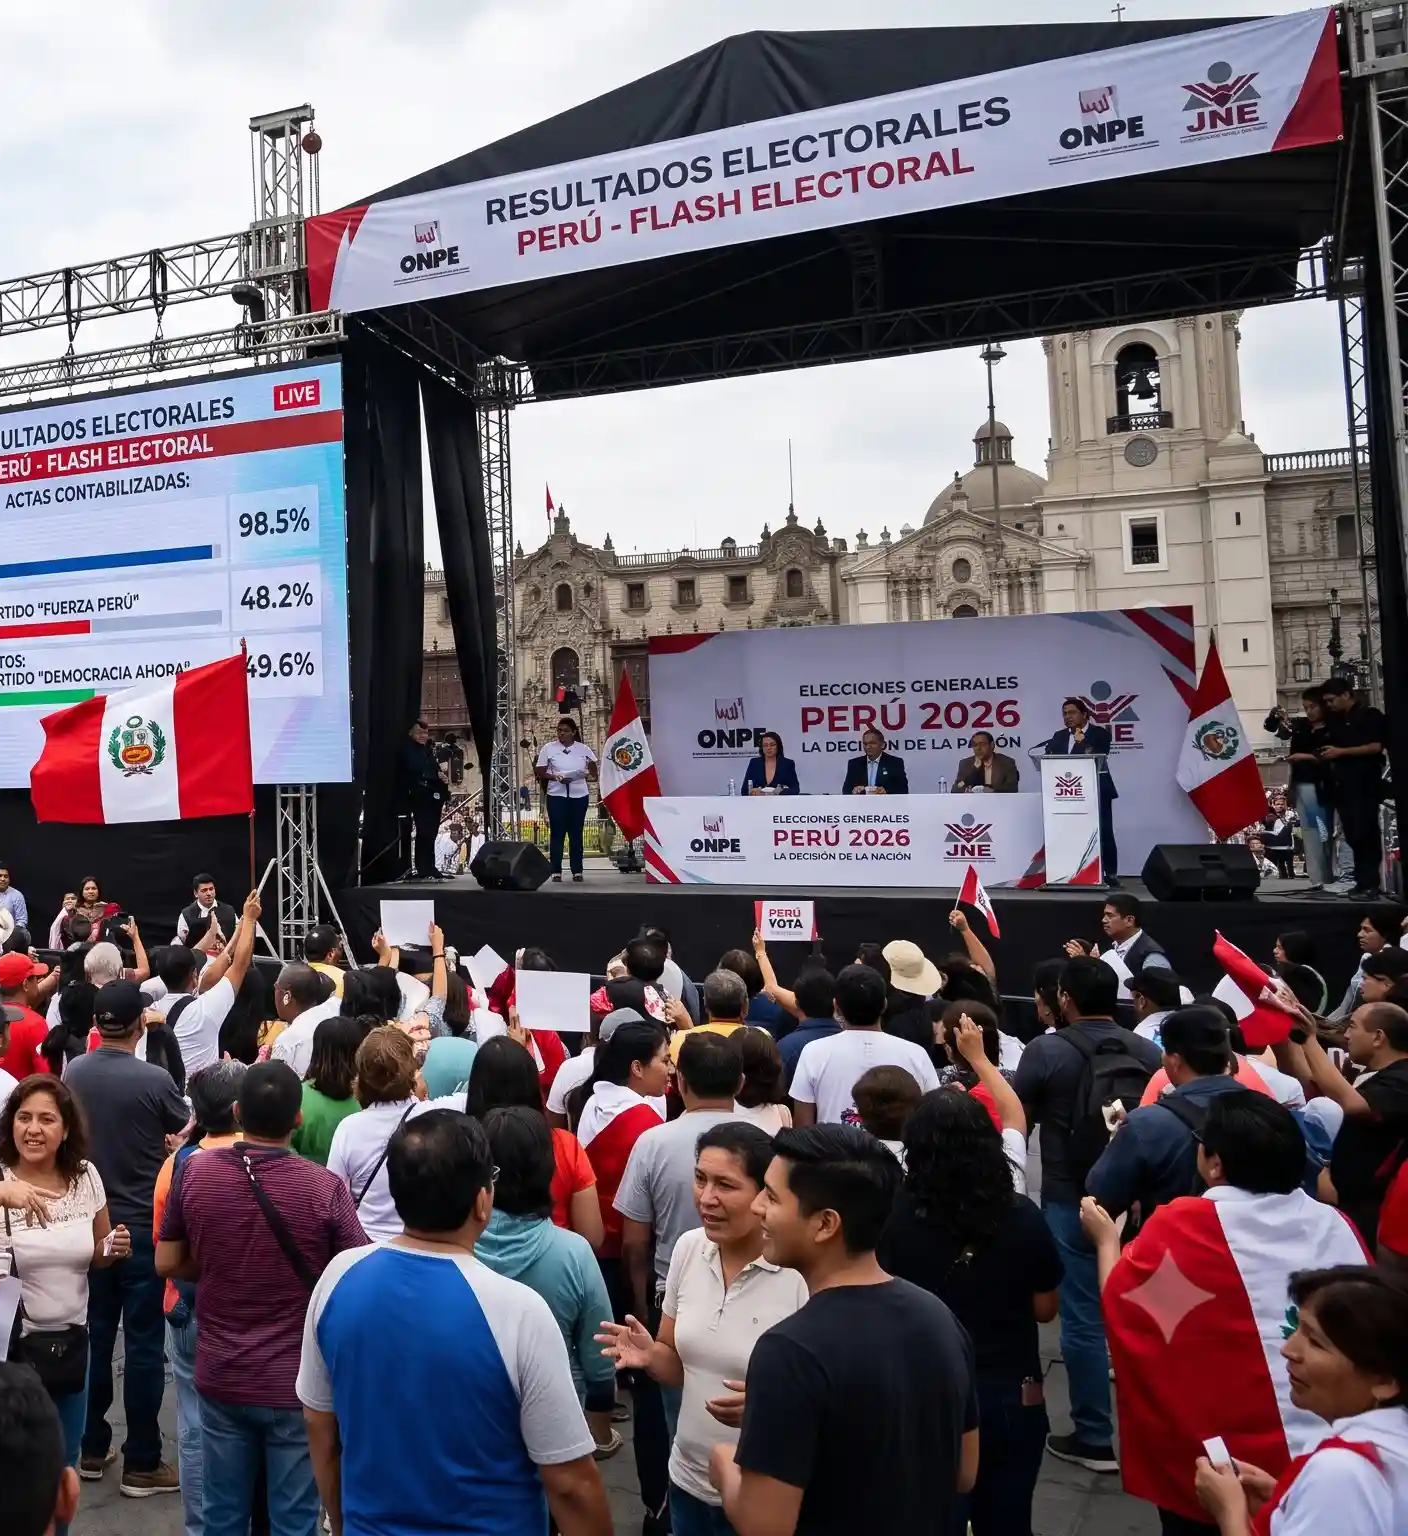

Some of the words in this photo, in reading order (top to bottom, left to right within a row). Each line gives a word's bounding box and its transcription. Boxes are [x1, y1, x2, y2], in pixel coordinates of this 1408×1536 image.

[1186, 102, 1260, 132] JNE
[1060, 115, 1144, 149] ONPE
[486, 156, 711, 225] RESULTADOS
[723, 96, 1011, 177] ELECTORALES
[518, 210, 602, 256] PERÚ
[630, 188, 741, 235] FLASH
[752, 147, 975, 210] ELECTORAL
[400, 246, 460, 273] ONPE
[279, 385, 316, 405] LIVE
[92, 396, 235, 437] ELECTORALES
[47, 447, 103, 474] FLASH
[108, 433, 214, 467] ELECTORAL
[5, 491, 52, 509] ACTAS
[55, 472, 190, 504] CONTABILIZADAS:
[239, 506, 310, 538] 98.5%
[241, 583, 314, 610] 48.2%
[799, 681, 906, 697] ELECCIONES
[911, 676, 1019, 693] GENERALES
[801, 697, 906, 733] PERÚ
[919, 699, 1021, 730] 2026
[802, 742, 821, 752] LA
[905, 738, 927, 751] DE
[932, 737, 952, 750] LA
[1056, 788, 1083, 796] JNE
[772, 815, 840, 824] ELECCIONES
[843, 814, 909, 823] GENERALES
[690, 838, 741, 853] ONPE
[773, 824, 840, 847] PERÚ
[849, 828, 910, 847] 2026
[773, 852, 787, 861] LA
[789, 850, 836, 861] DECISIÓN
[839, 852, 853, 861] DE
[855, 852, 869, 861] LA
[871, 851, 911, 861] NACIÓN
[946, 844, 992, 857] JNE
[768, 918, 804, 929] VOTA
[769, 906, 801, 918] PERÚ
